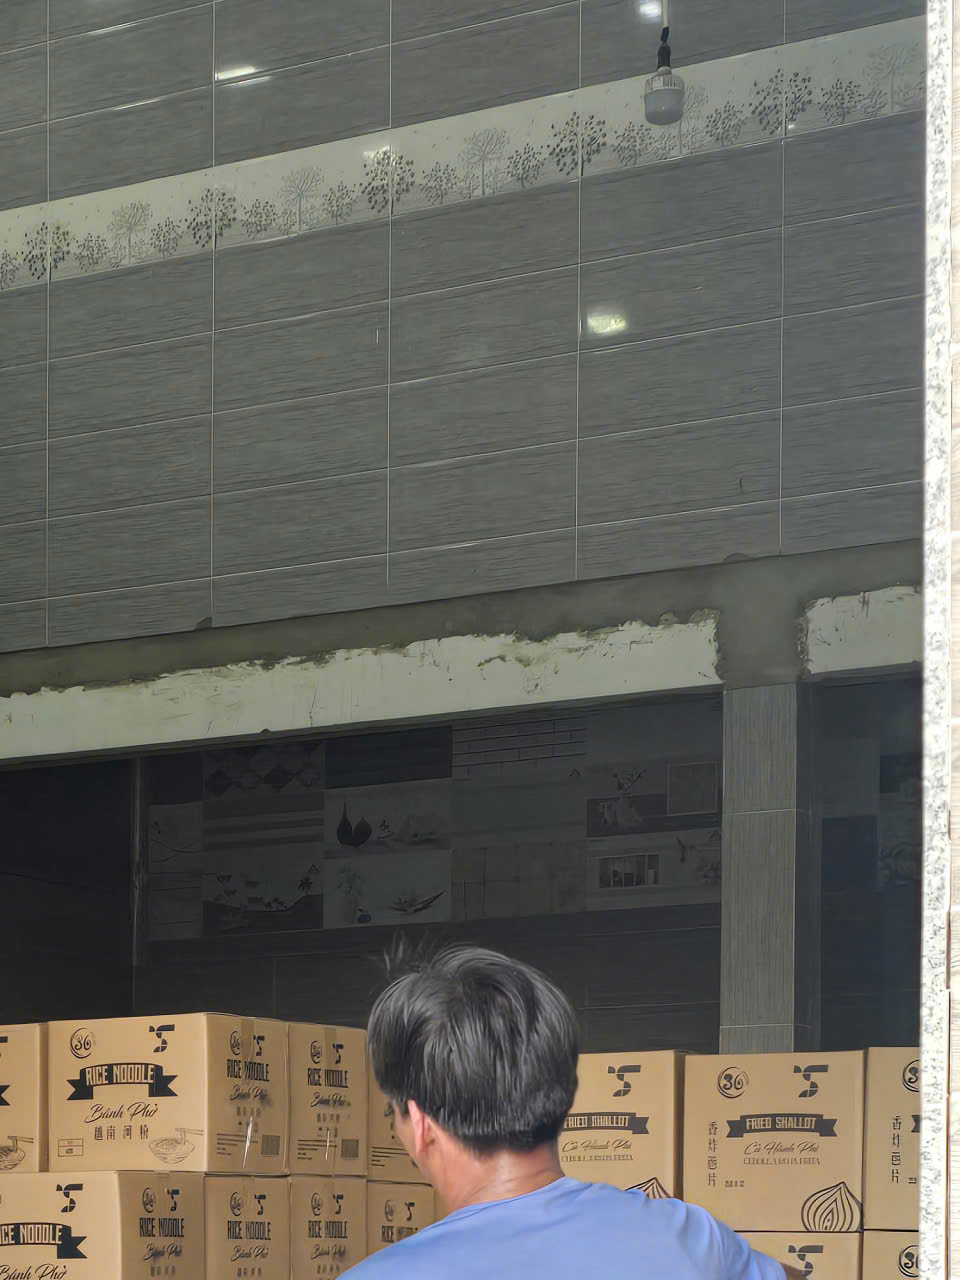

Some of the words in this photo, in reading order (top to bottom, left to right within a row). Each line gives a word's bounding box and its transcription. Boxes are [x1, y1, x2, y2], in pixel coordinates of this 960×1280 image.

[74, 1034, 92, 1050] 36
[86, 1066, 108, 1086] RICE
[112, 1064, 154, 1083] NOODLE
[227, 1059, 241, 1078] RICE
[723, 1074, 744, 1090] 36
[746, 1118, 772, 1130] FRIED
[776, 1117, 816, 1128] SHALLOT
[20, 1224, 62, 1244] NOODLE
[140, 1218, 155, 1237] RICE
[228, 1221, 242, 1240] RICE
